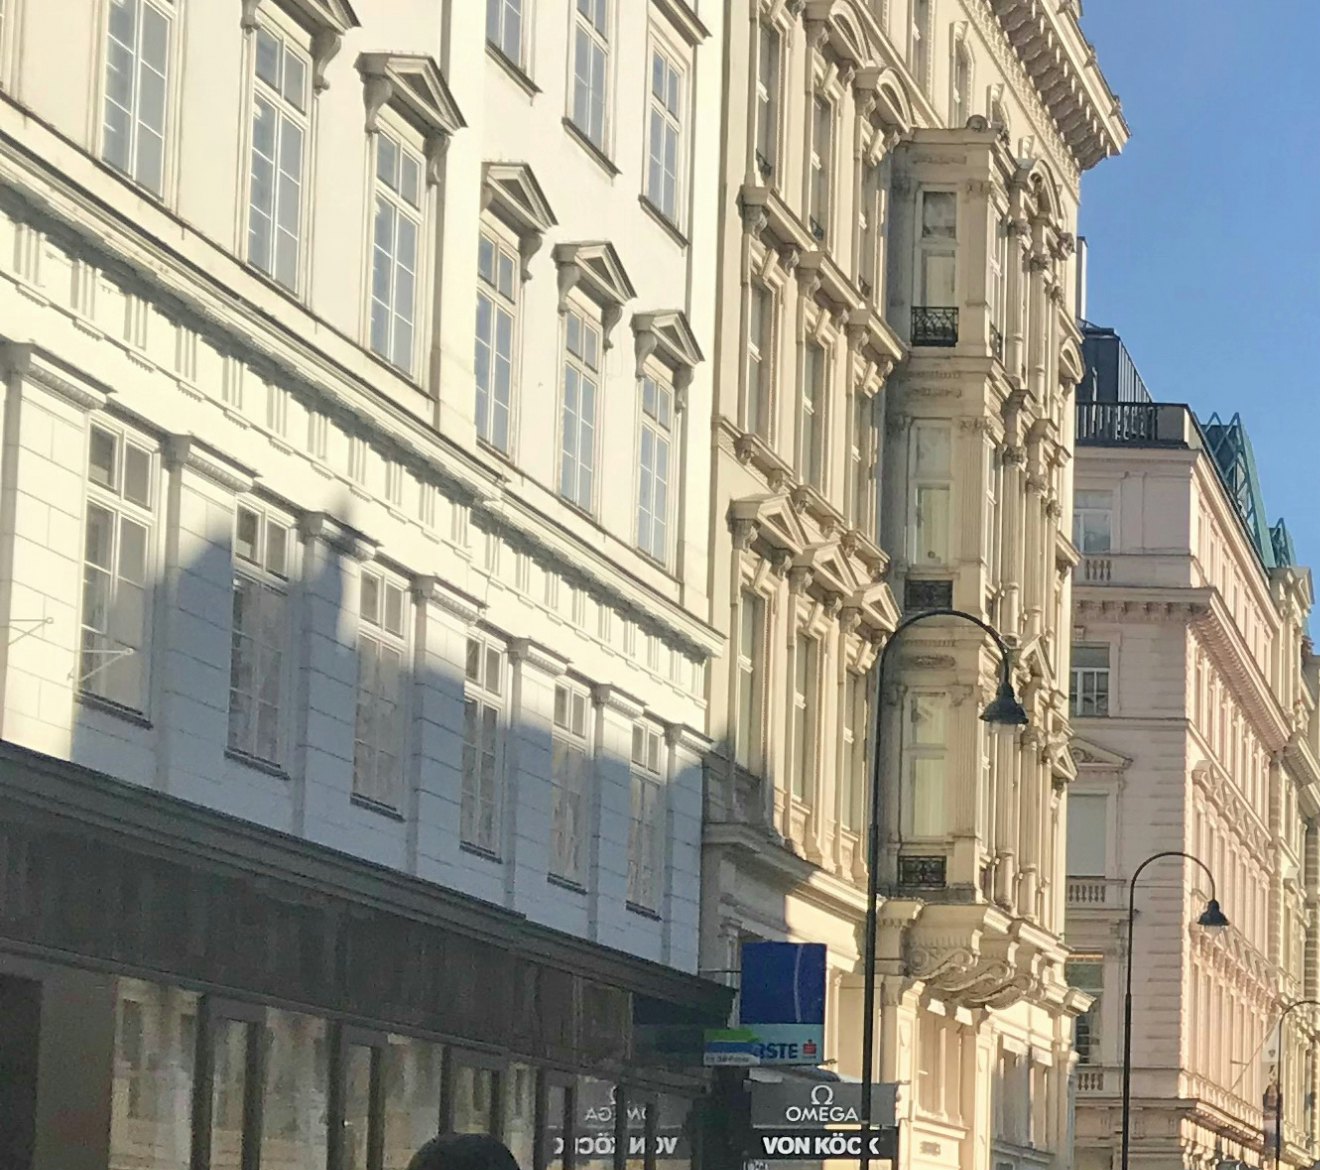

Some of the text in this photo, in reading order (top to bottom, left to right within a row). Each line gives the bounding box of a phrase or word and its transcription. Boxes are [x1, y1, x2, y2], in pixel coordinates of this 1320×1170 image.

[757, 1043, 799, 1060] RSTE
[785, 1106, 859, 1122] OMEGA
[763, 1132, 881, 1155] VON KÖCK
